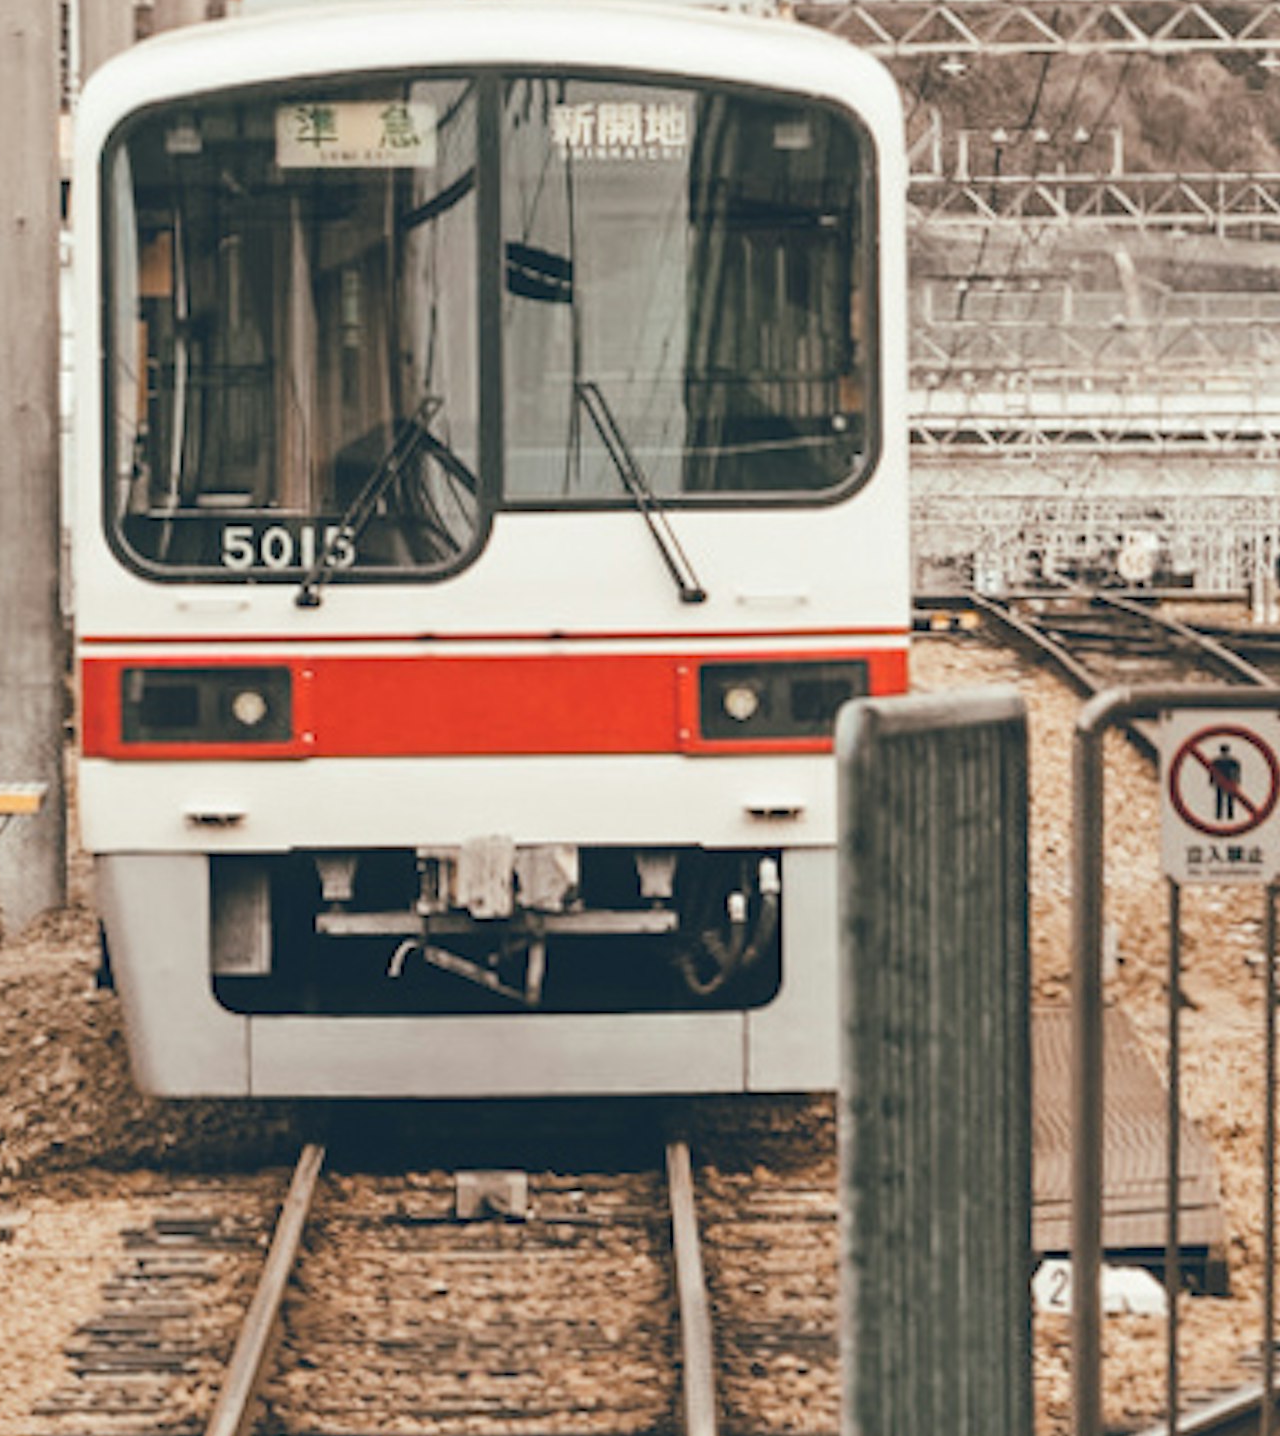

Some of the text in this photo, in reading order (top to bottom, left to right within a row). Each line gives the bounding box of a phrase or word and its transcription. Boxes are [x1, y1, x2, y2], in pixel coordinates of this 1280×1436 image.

[295, 104, 422, 148] 準急
[548, 102, 688, 146] 新開地
[221, 525, 357, 570] 5015
